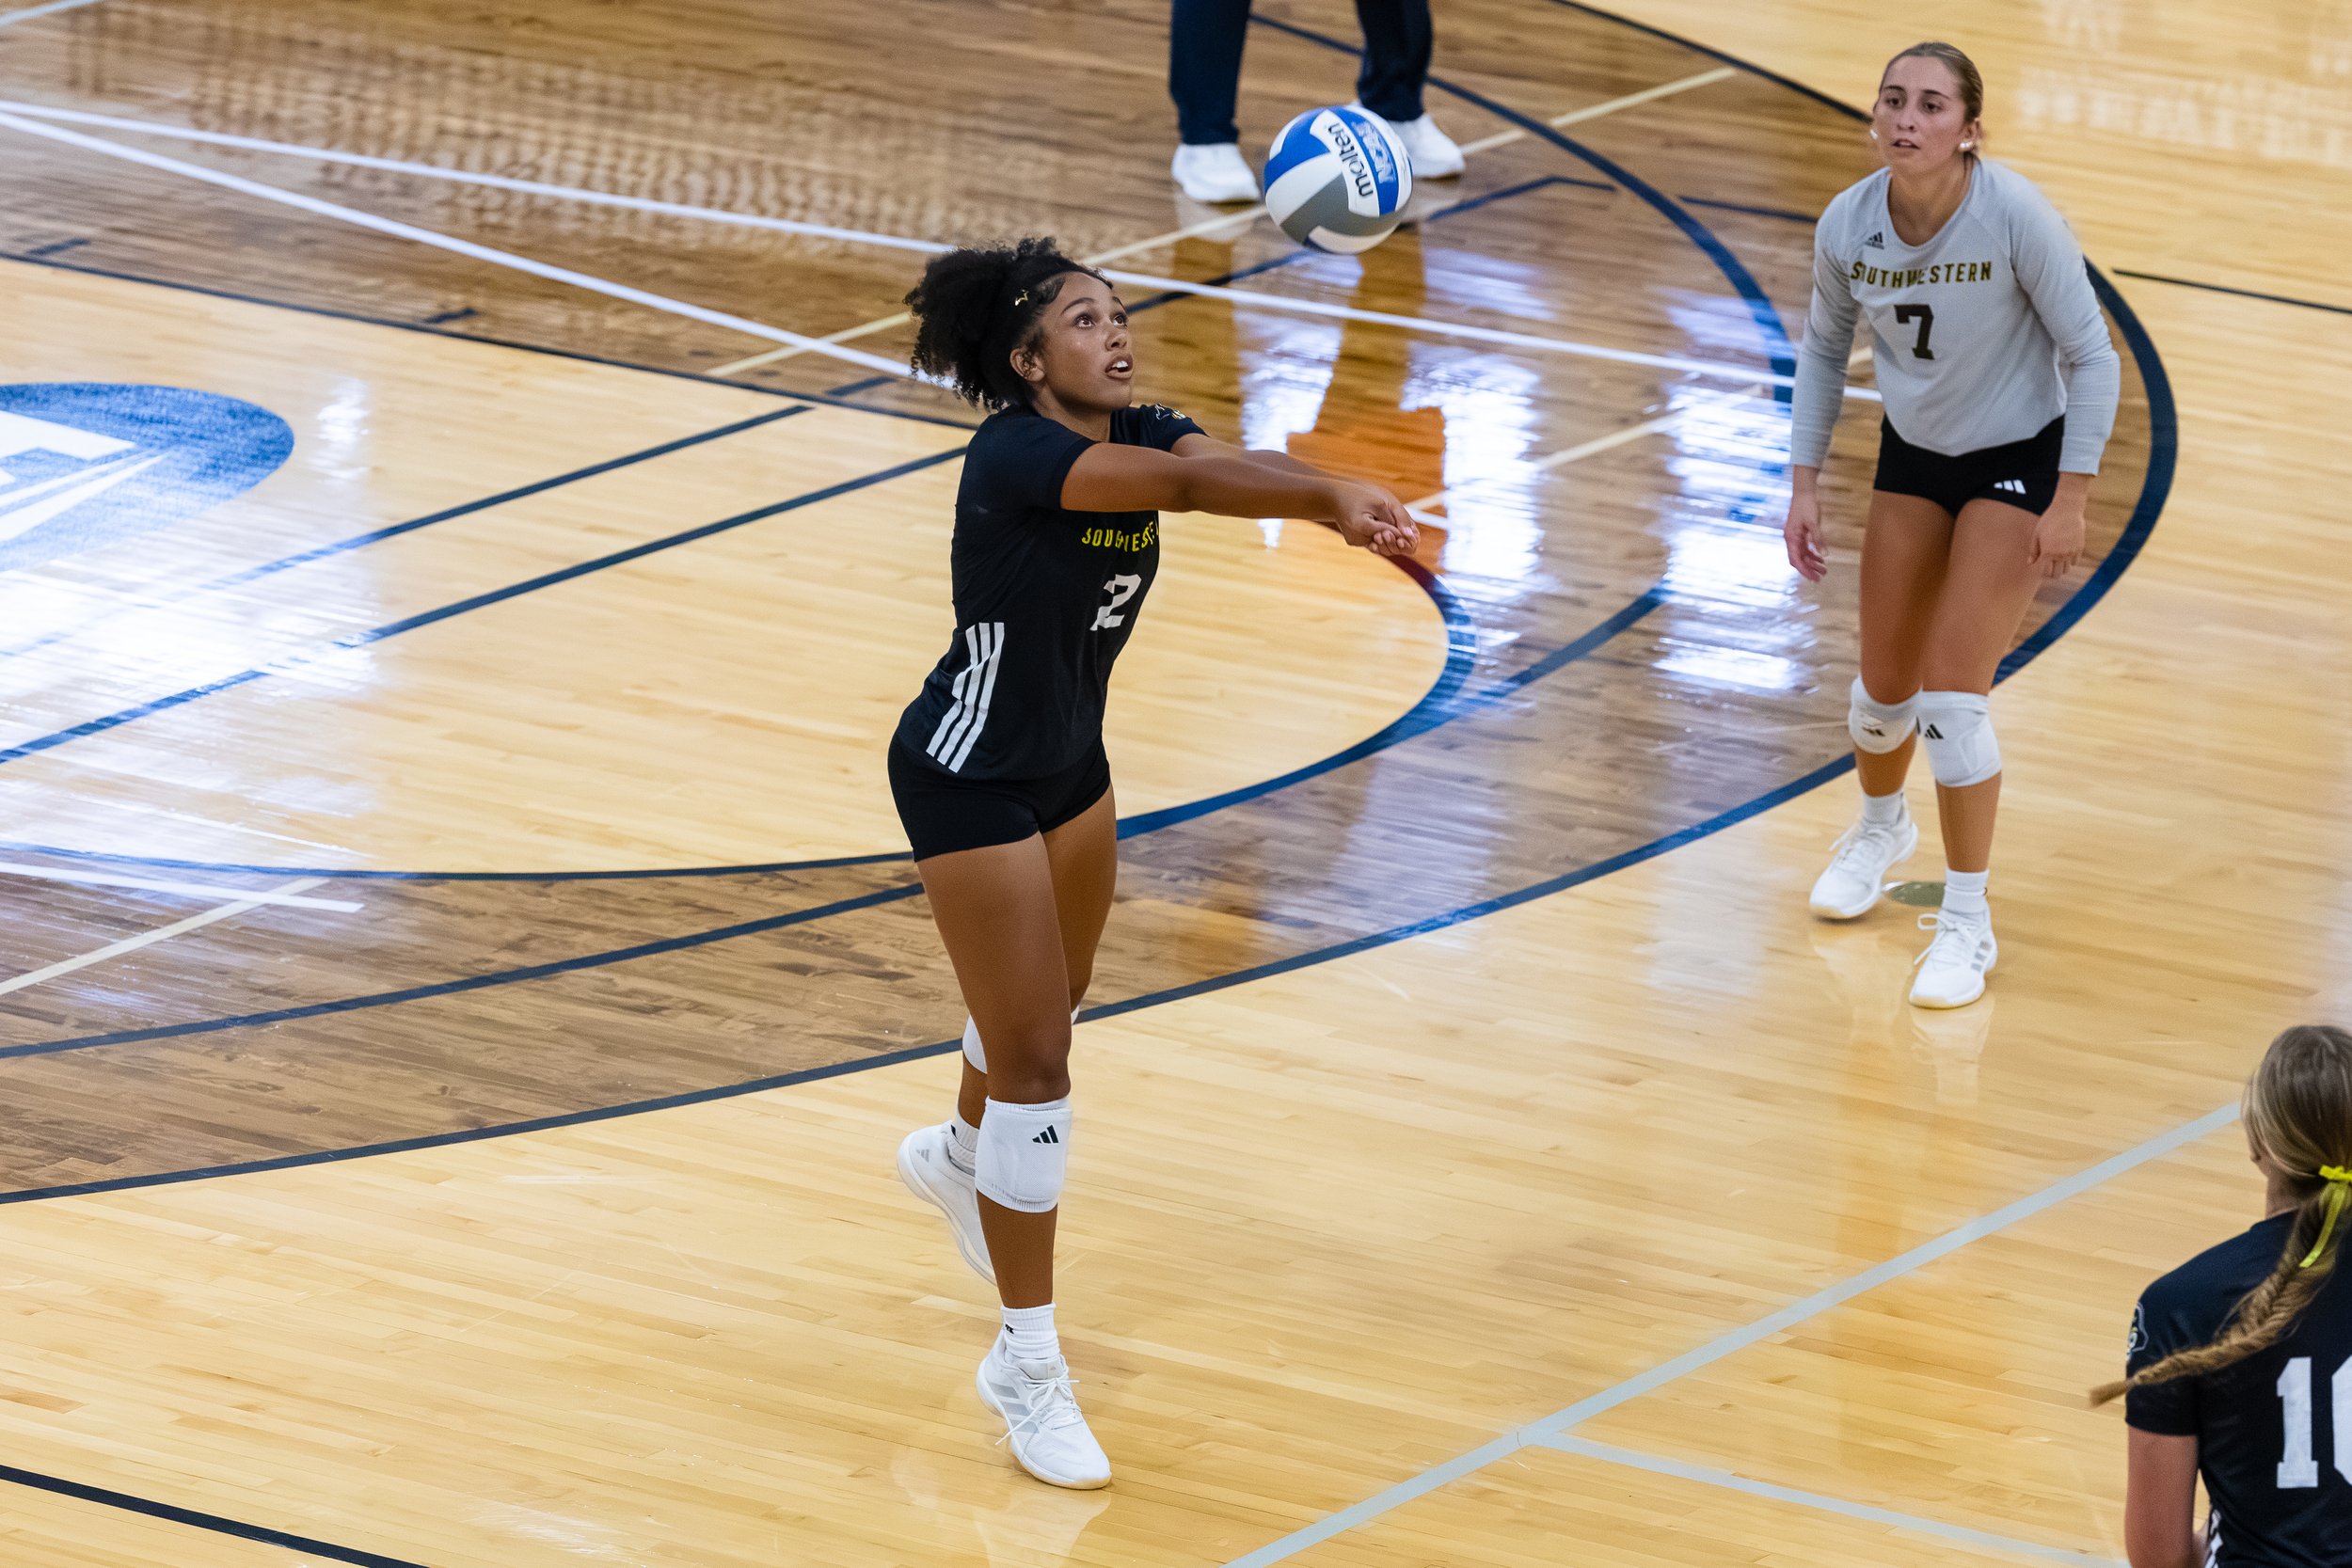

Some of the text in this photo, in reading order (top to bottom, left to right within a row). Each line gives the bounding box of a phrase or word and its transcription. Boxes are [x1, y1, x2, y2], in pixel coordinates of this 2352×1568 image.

[1327, 122, 1375, 198] molten
[1894, 303, 1935, 359] 7
[1089, 573, 1142, 632] 2
